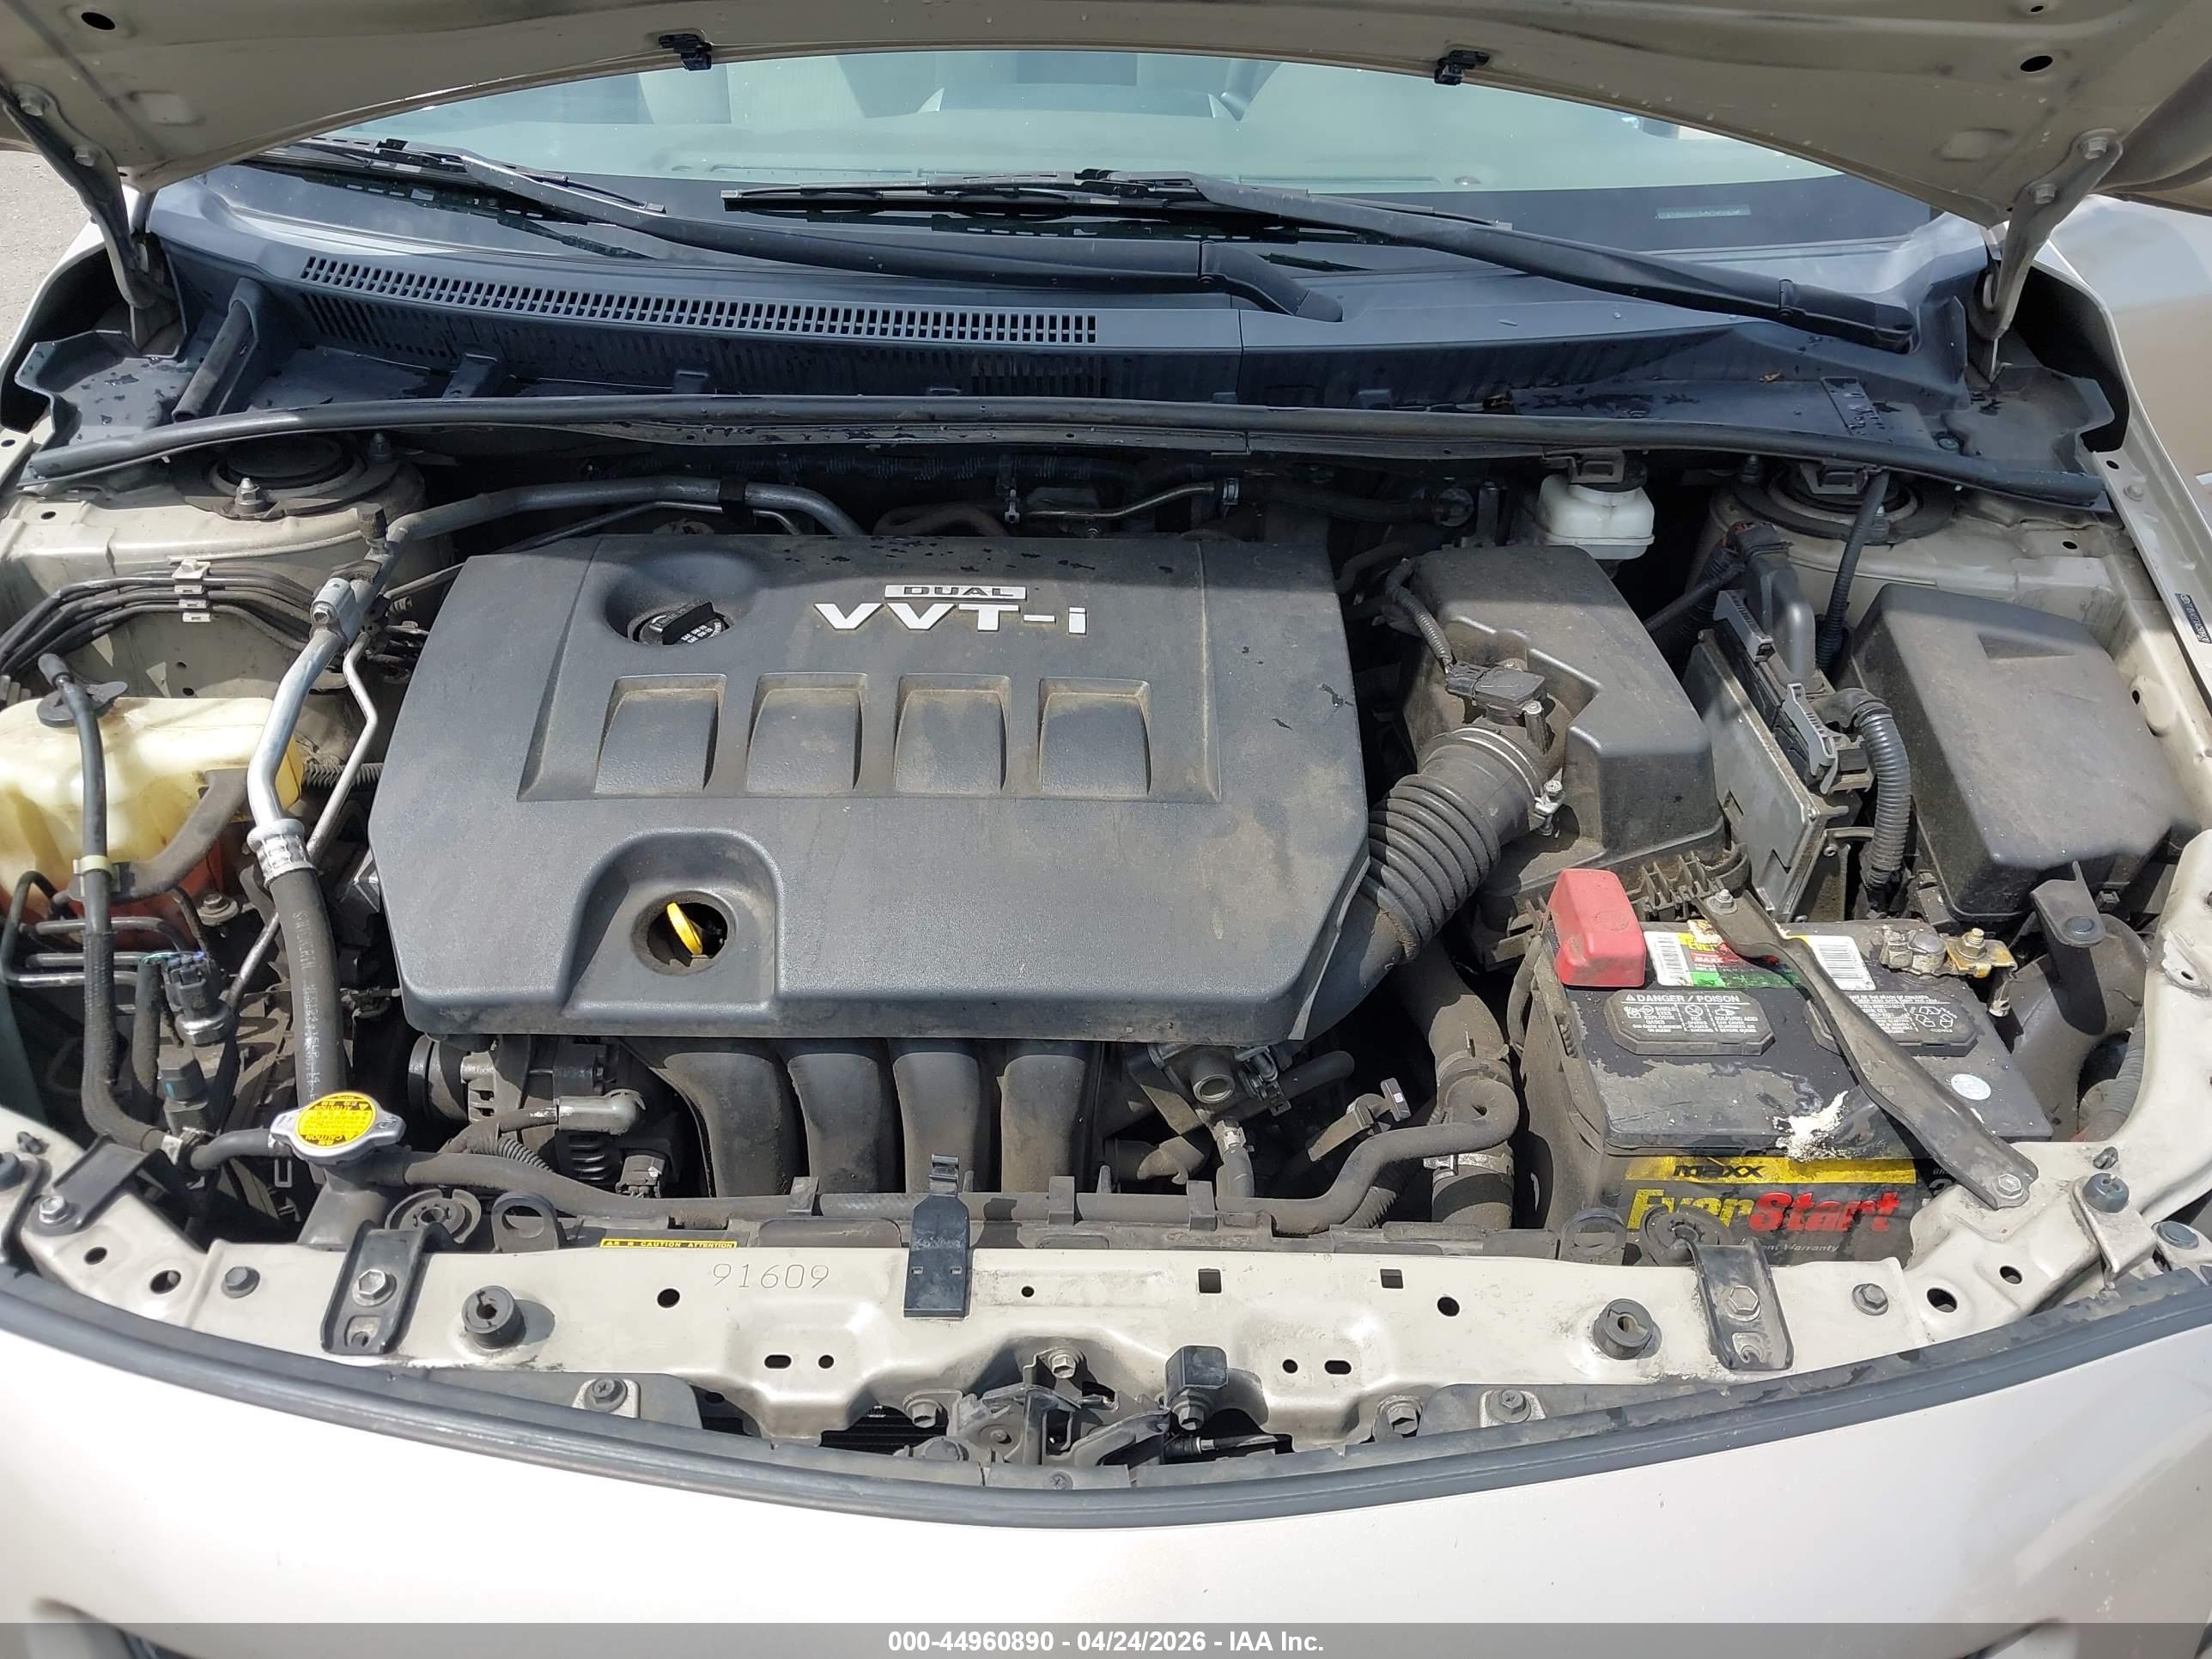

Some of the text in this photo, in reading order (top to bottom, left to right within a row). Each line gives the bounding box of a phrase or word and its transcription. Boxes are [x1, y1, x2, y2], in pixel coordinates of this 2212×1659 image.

[902, 586, 1014, 597] DUAL
[813, 603, 1086, 635] VVT-i
[1782, 1243, 1840, 1252] Warranty
[712, 1263, 830, 1289] 91609
